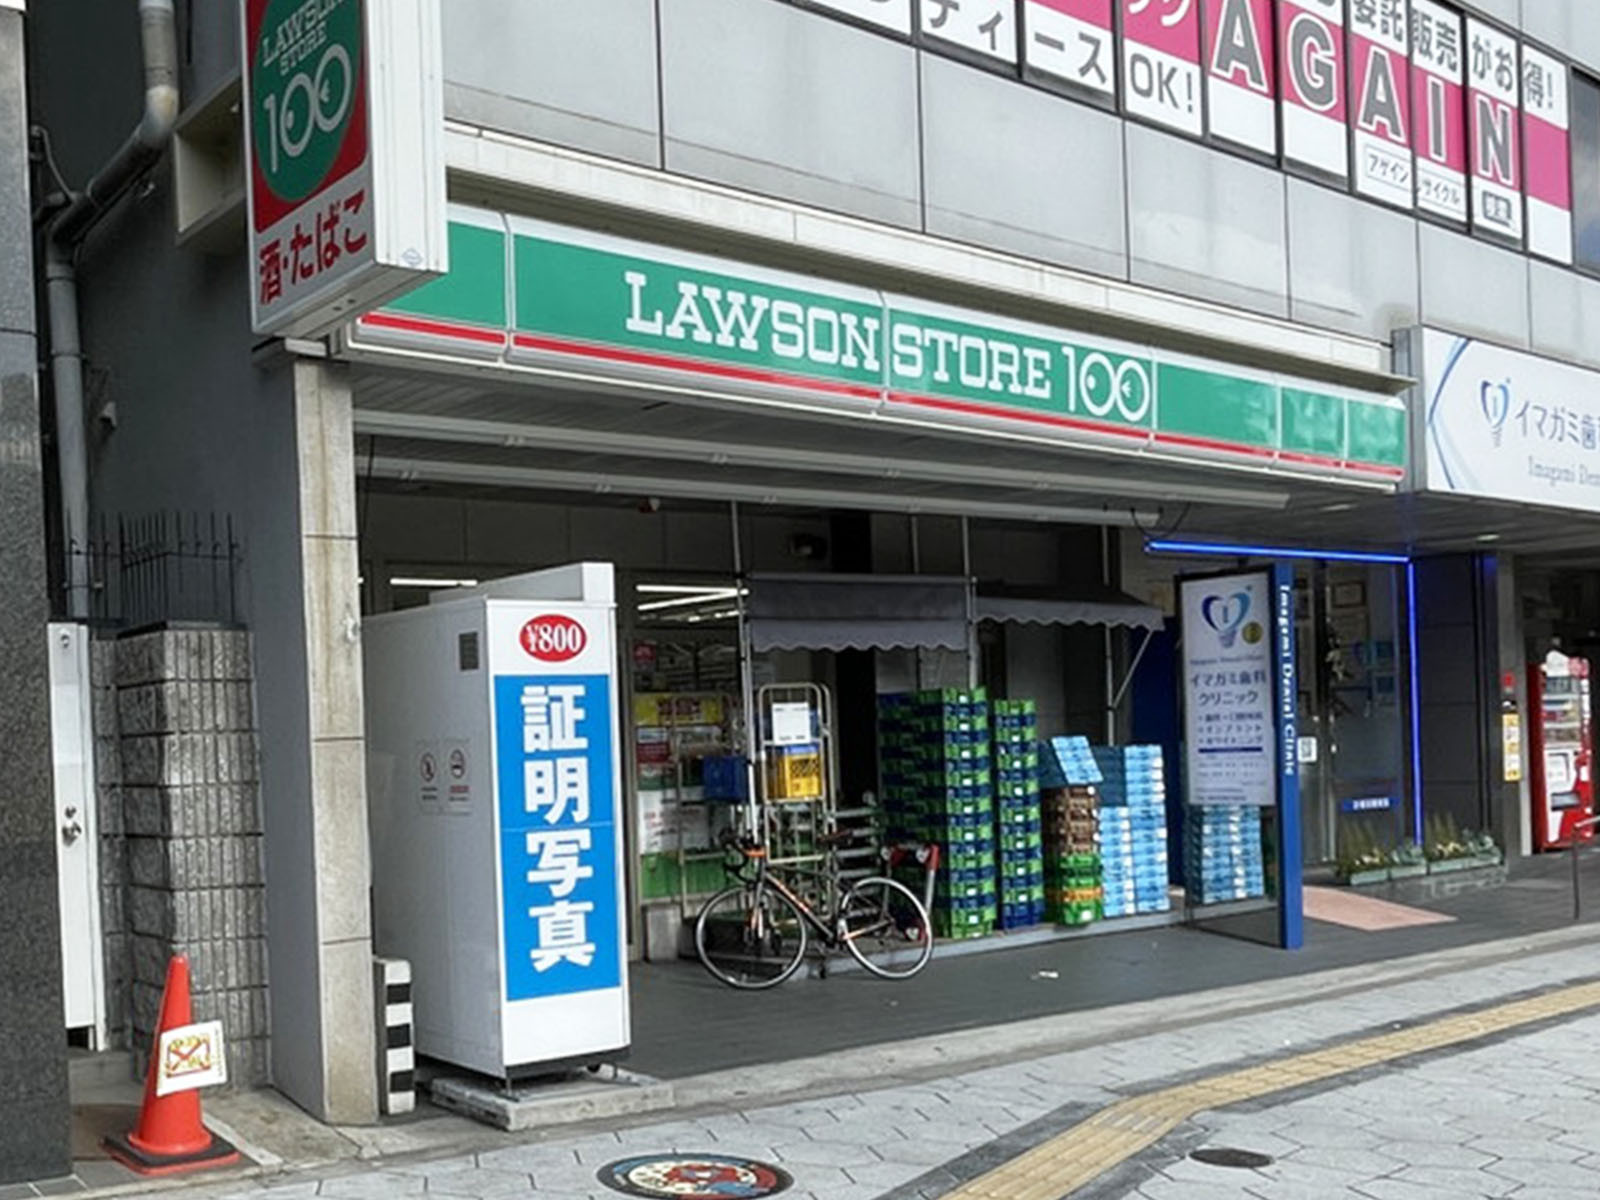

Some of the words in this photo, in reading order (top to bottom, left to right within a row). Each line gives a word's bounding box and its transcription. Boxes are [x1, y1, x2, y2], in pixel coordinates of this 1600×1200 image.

[263, 0, 342, 67] LAWSO
[280, 21, 328, 76] STORE
[263, 43, 352, 173] 100
[1211, 0, 1517, 186] AGAIN
[259, 188, 368, 305] 酒・たばこ
[625, 270, 881, 372] LAWSON
[893, 324, 1052, 399] STORE
[1062, 346, 1151, 421] 100
[1515, 400, 1600, 450] イマガミ歯
[527, 624, 583, 652] ¥800
[1199, 690, 1259, 707] クリニック
[520, 684, 597, 973] 証明写真
